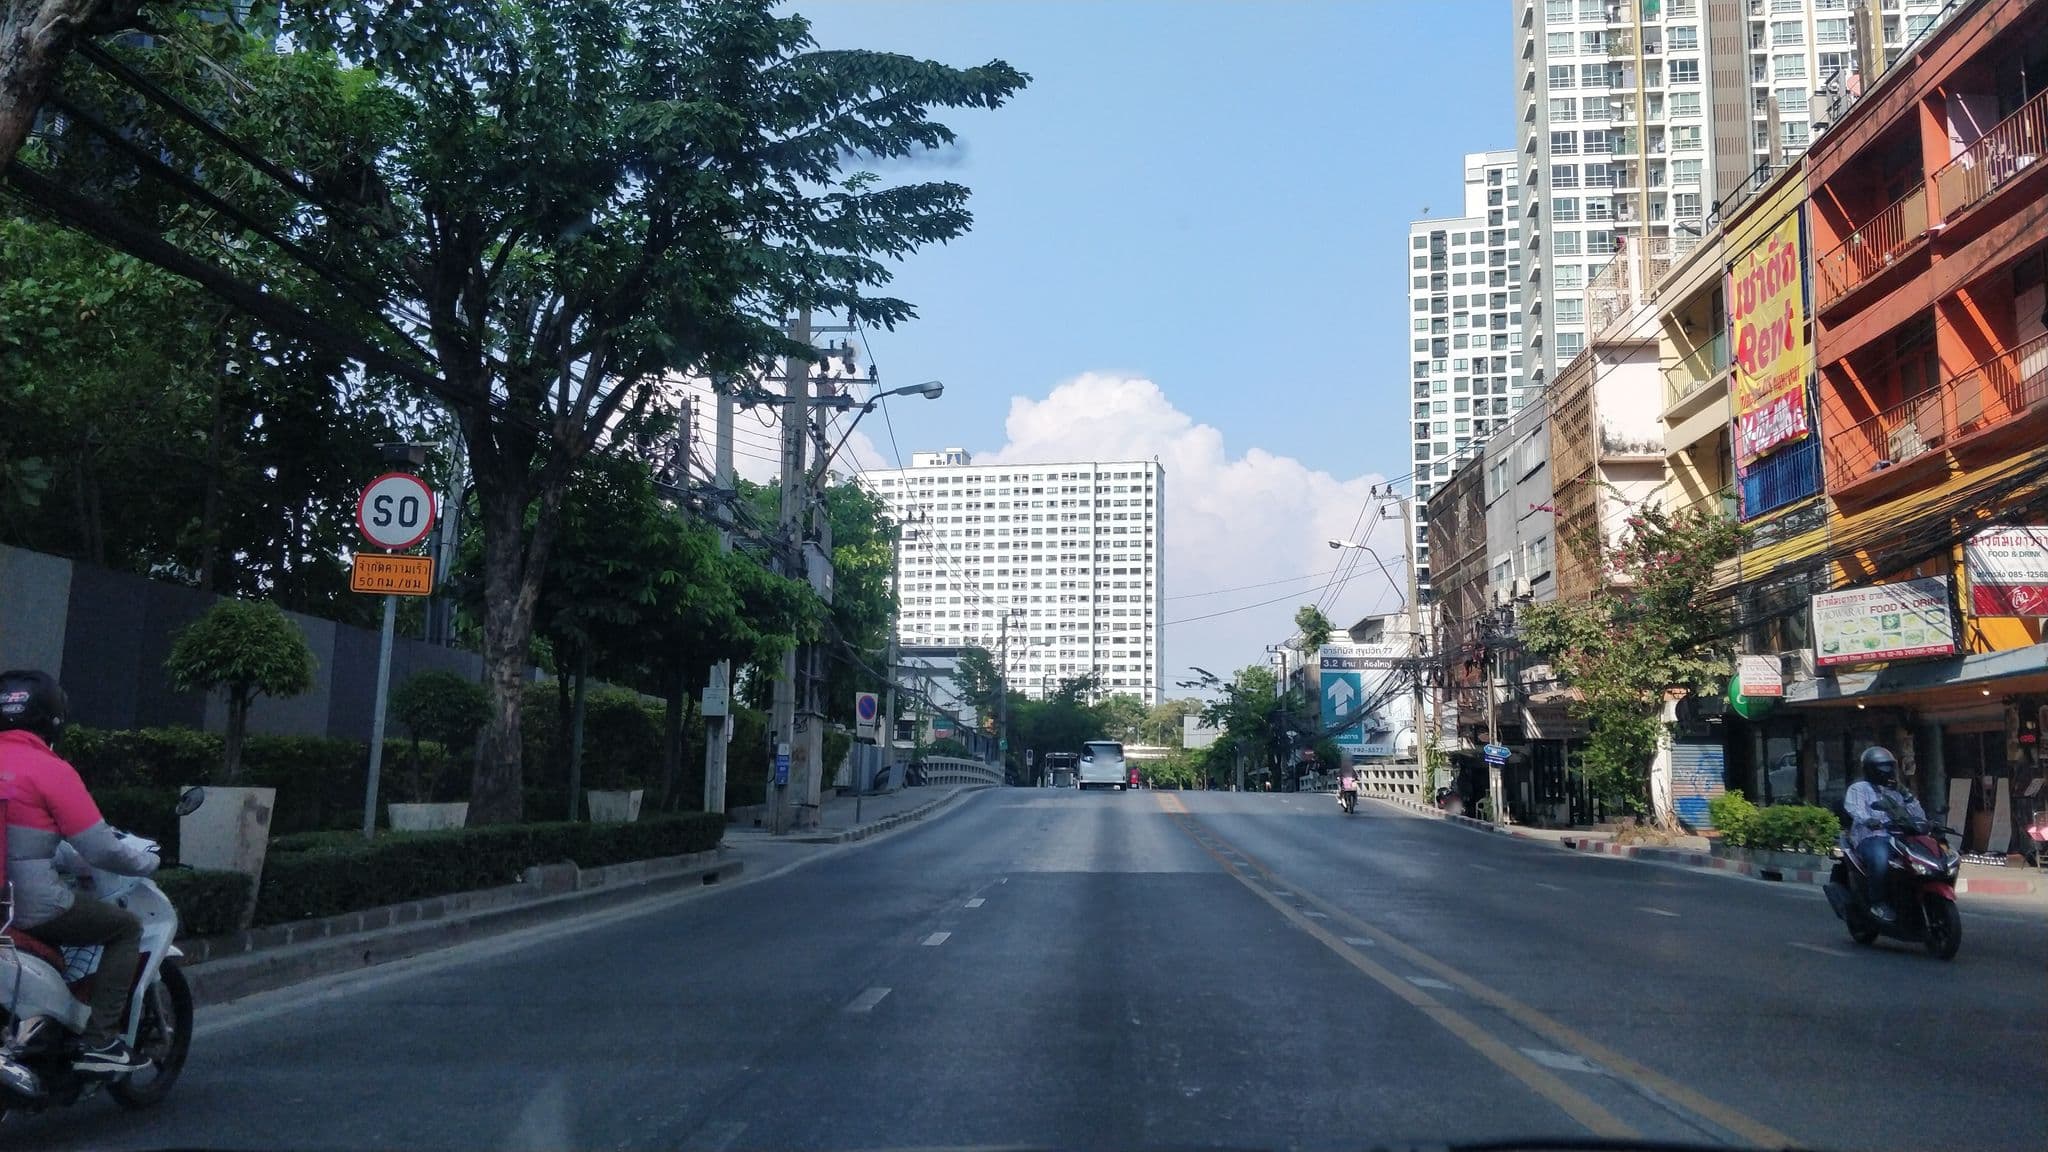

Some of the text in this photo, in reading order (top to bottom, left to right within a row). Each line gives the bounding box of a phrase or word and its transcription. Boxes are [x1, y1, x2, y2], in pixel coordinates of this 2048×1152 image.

[1737, 298, 1795, 376] Rent
[372, 494, 419, 528] 50
[1988, 550, 2042, 558] FOOD & DRINK
[359, 577, 374, 587] 50
[1869, 602, 1898, 615] FOOD
[1900, 601, 1909, 610] &
[1323, 659, 1339, 668] 3.2
